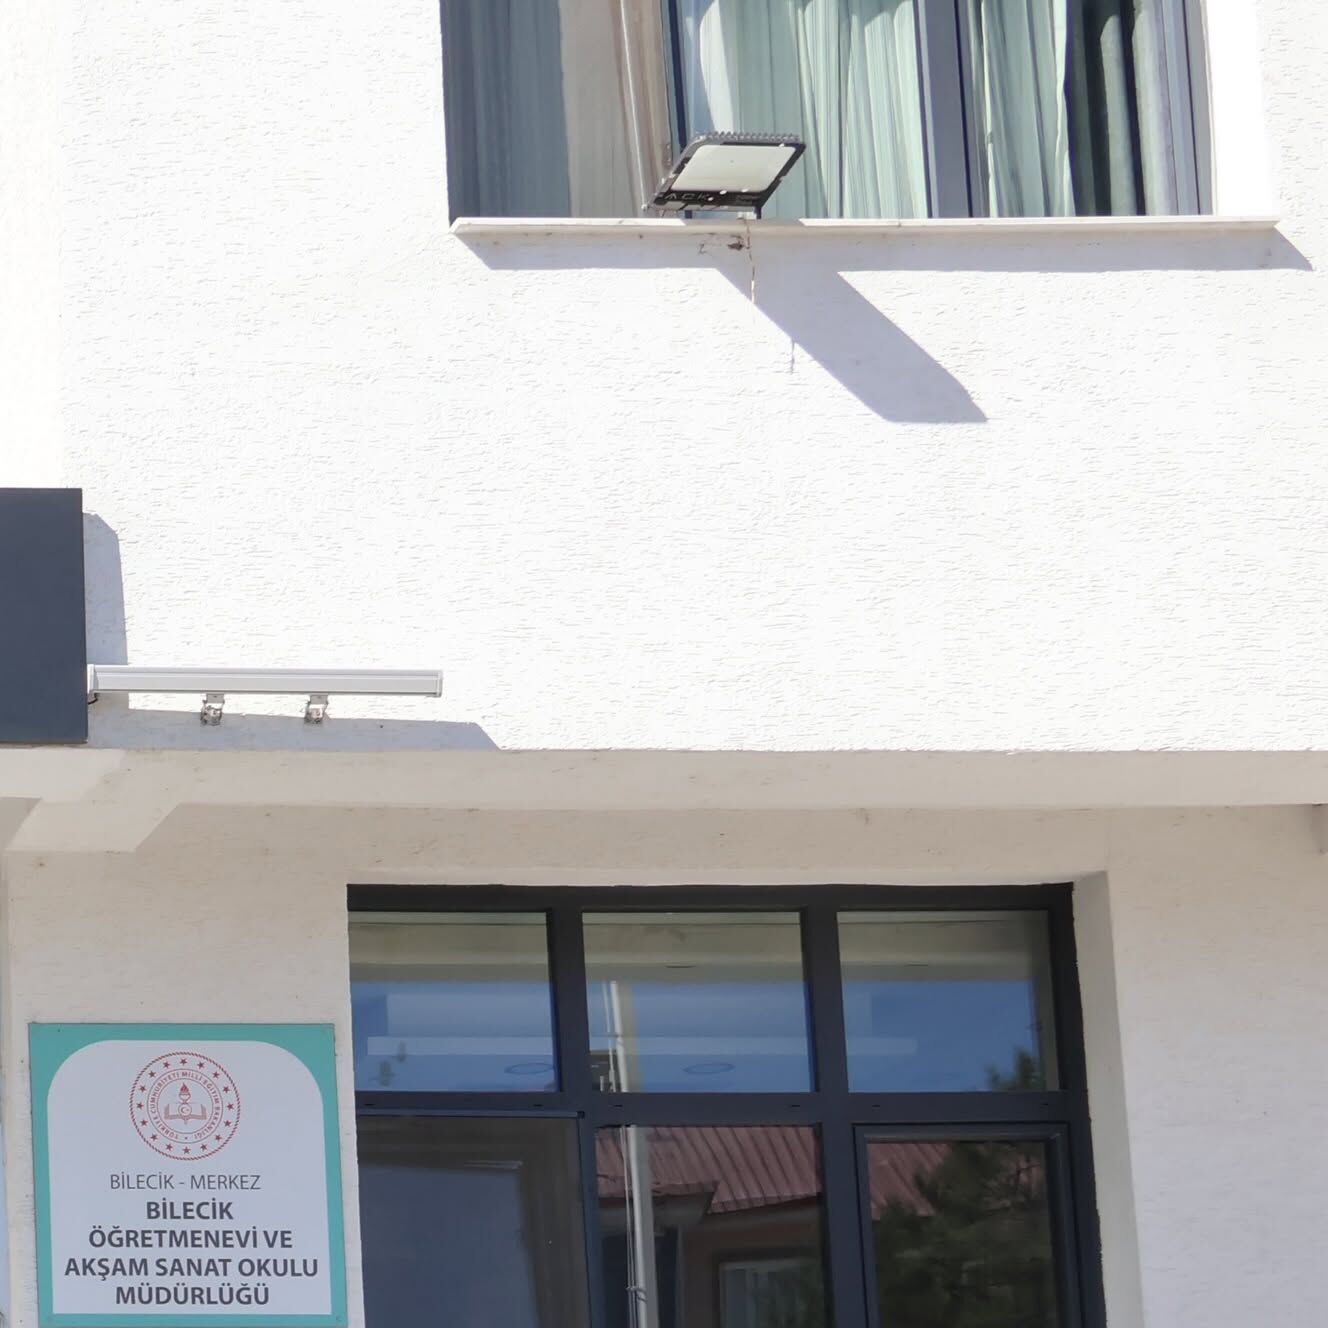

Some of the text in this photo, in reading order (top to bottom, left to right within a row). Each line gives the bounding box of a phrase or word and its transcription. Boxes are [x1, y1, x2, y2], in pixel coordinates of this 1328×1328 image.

[110, 1171, 175, 1190] BİLECİK
[190, 1174, 261, 1190] MERKEZ
[146, 1197, 234, 1220] BİLECİK
[88, 1225, 293, 1249] ÖĞRETMENEVİ VE
[64, 1257, 318, 1282] AKŞAM SANAT OKULU
[115, 1282, 270, 1305] MÜDÜRLÜĞÜ
